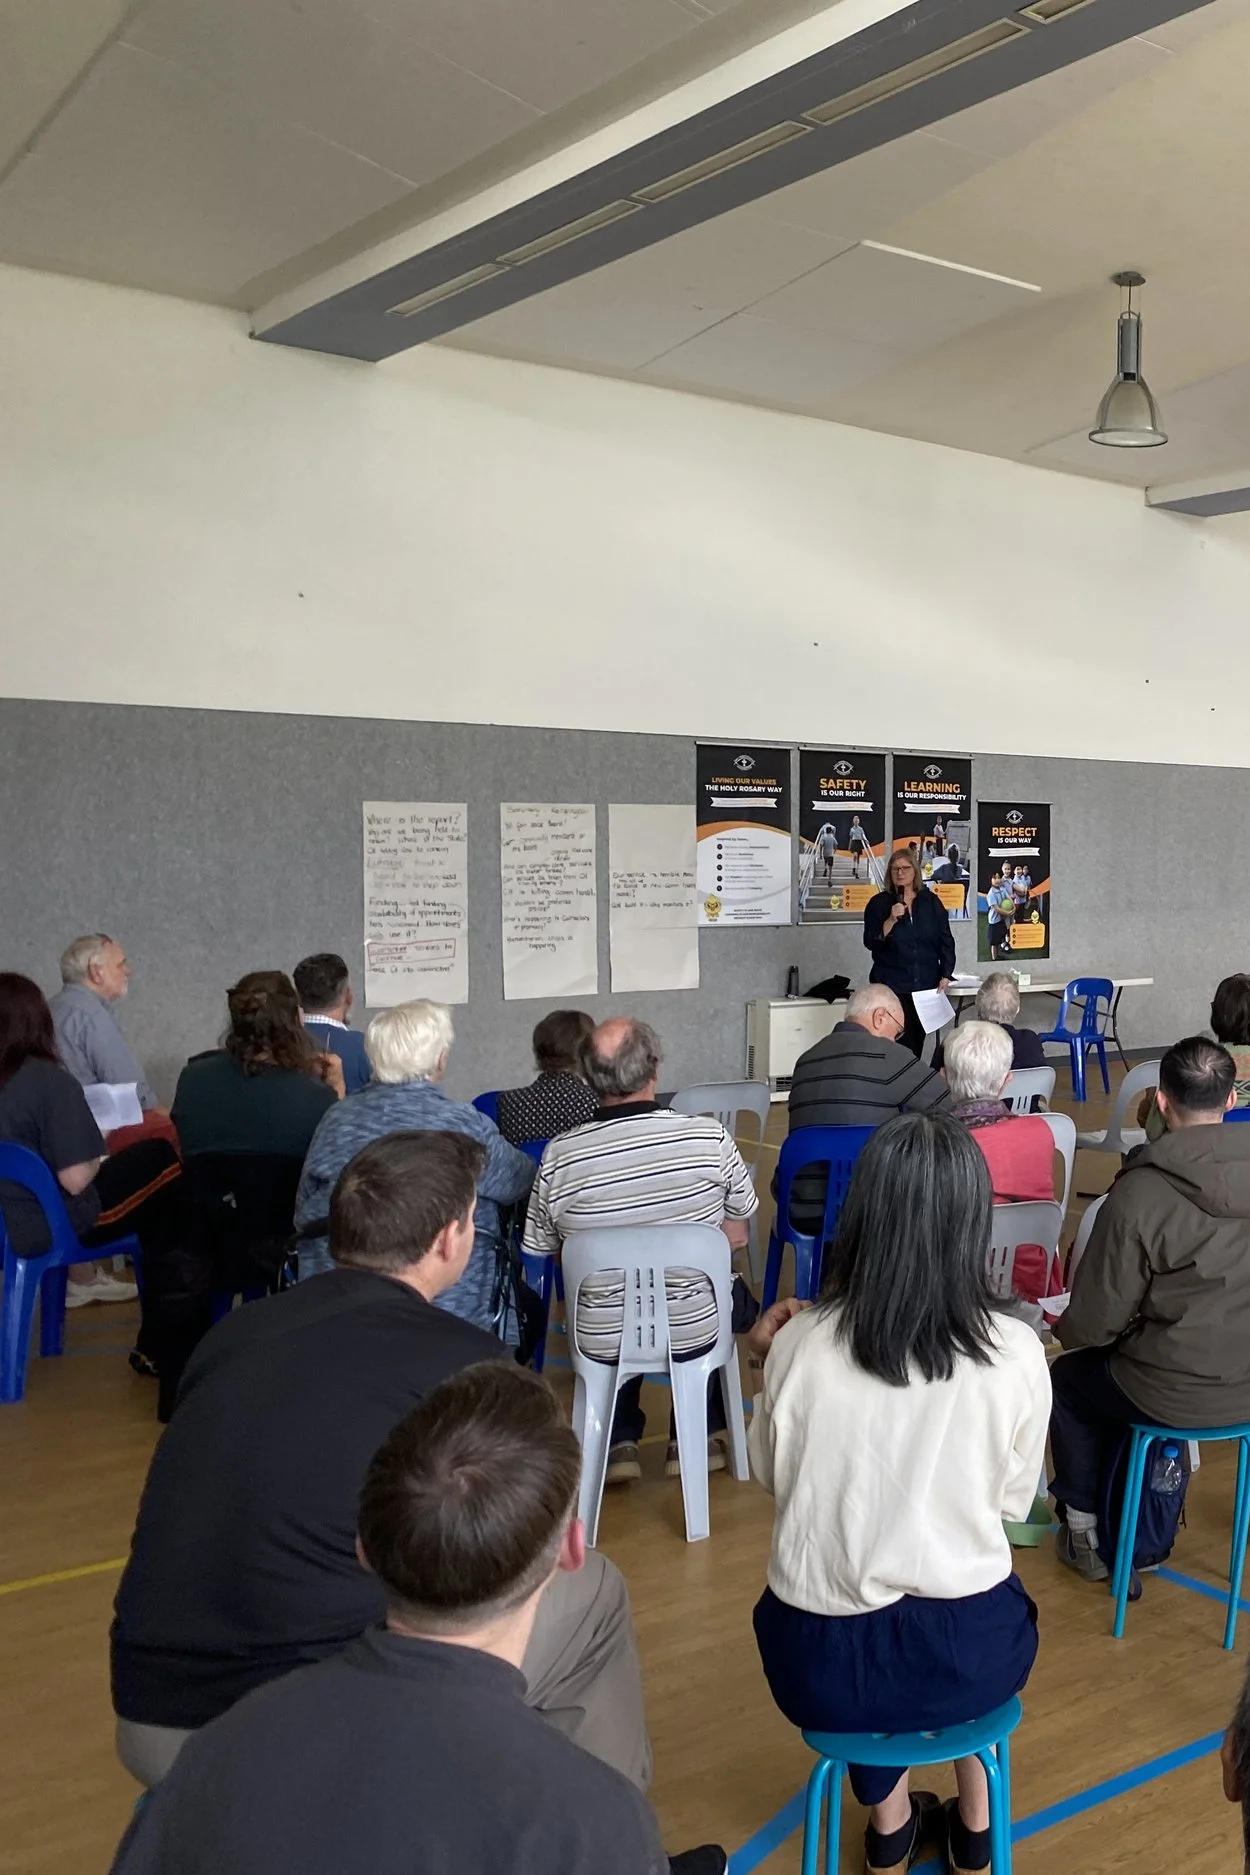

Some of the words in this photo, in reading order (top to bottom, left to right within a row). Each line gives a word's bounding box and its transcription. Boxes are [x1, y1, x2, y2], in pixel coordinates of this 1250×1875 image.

[750, 778, 777, 786] VALUES
[819, 778, 867, 790] SAFETY
[739, 785, 767, 793] ROSARY
[767, 786, 783, 794] WAY
[904, 781, 961, 794] LEARNING
[845, 790, 866, 798] RIGHT
[919, 792, 967, 801] RESPONSIBILITY
[991, 827, 1037, 837] RESPECT
